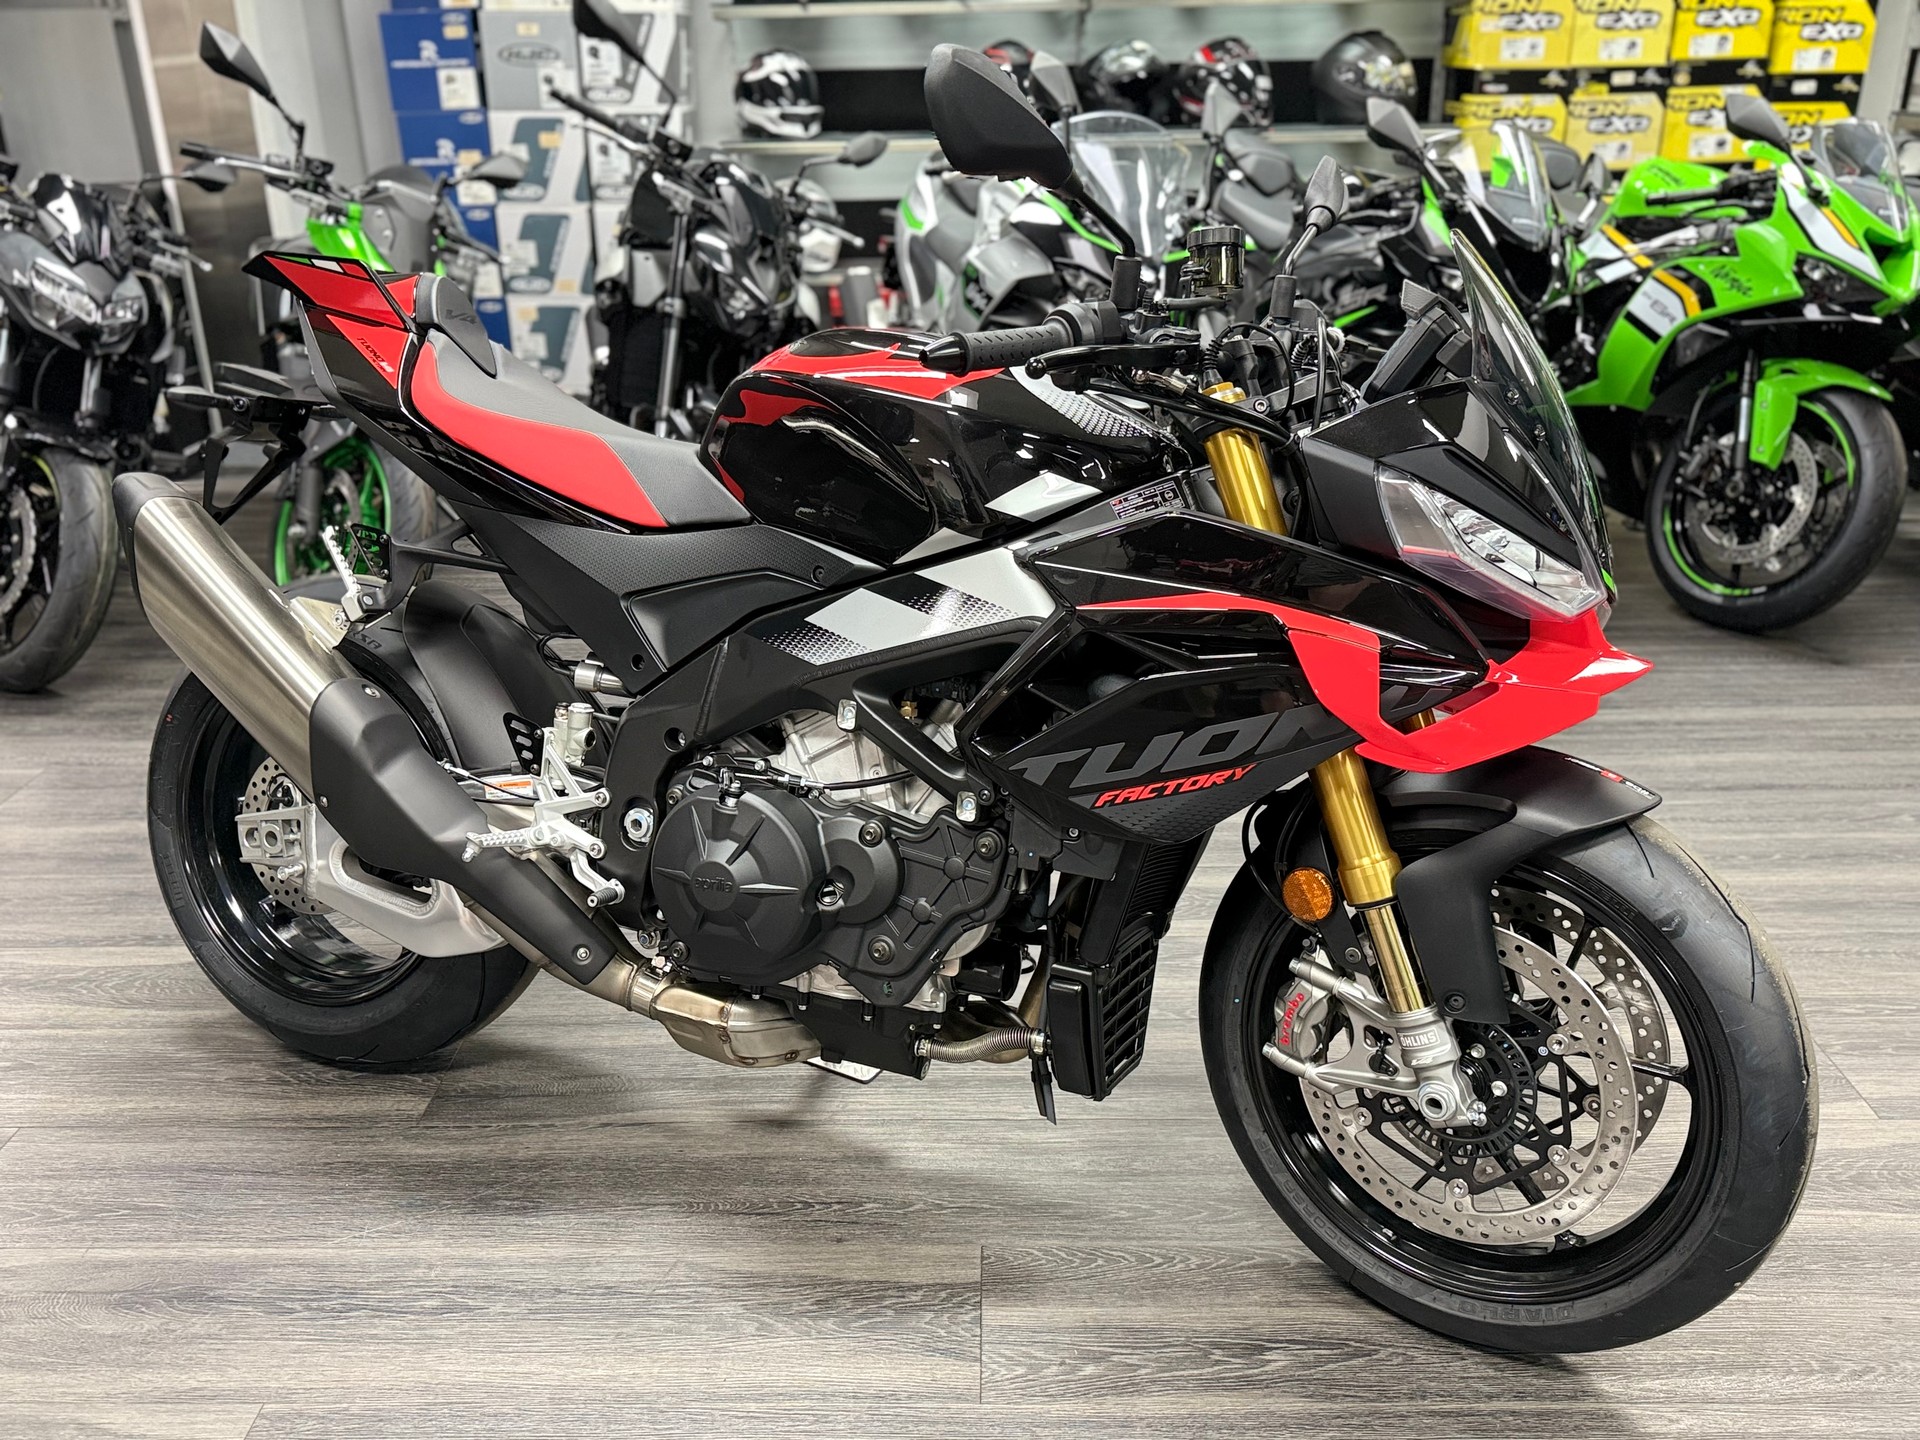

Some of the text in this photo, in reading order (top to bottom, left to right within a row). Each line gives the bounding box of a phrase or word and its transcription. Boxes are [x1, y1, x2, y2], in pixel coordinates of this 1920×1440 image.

[1500, 11, 1562, 31] EXO
[1596, 11, 1661, 30] EXO
[1697, 8, 1761, 27] EXO
[1800, 21, 1864, 41] EXO
[1587, 115, 1650, 133] EXO
[1008, 702, 1348, 788] TUON
[1092, 763, 1258, 809] FACTORY
[695, 876, 734, 893] aprilia
[1279, 992, 1305, 1047] brembo
[1282, 1178, 1405, 1287] SUPERCORSA
[1458, 1303, 1576, 1322] DIABLO
